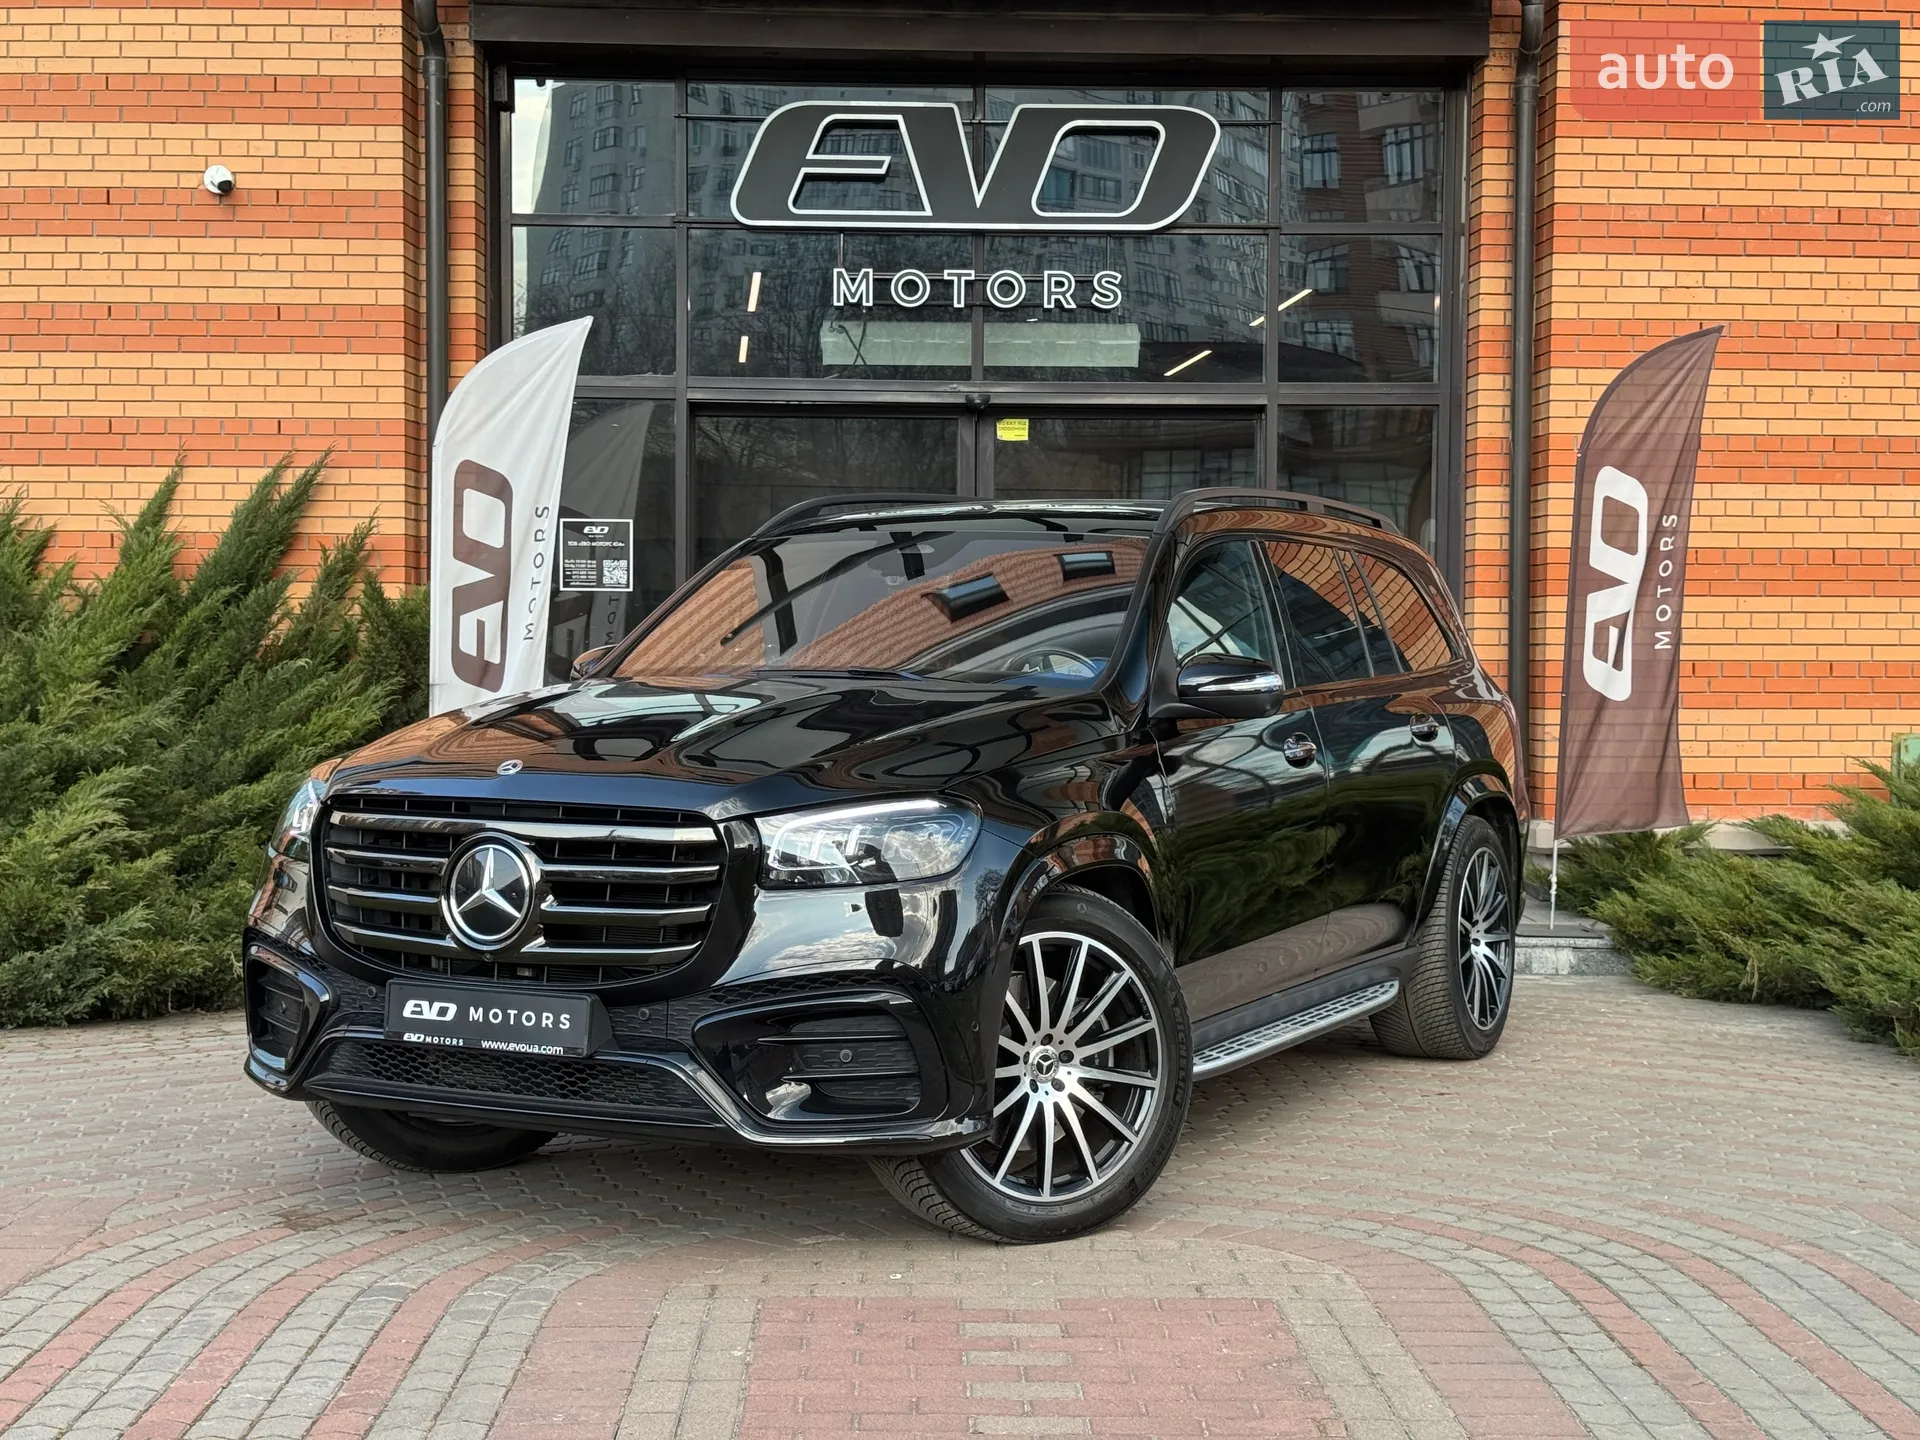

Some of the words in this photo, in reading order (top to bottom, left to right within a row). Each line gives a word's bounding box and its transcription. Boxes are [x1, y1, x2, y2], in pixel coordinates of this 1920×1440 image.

[730, 100, 1221, 231] EVO
[832, 268, 1123, 309] MOTORS
[583, 525, 609, 534] EVO
[451, 459, 514, 693] EVO
[523, 505, 549, 641] MOTORS
[1583, 465, 1648, 701] EVO
[1654, 513, 1678, 650] MOTORS
[402, 999, 457, 1022] EVO
[469, 1006, 571, 1030] MOTORS
[402, 1032, 425, 1042] EVO
[425, 1036, 464, 1046] MOTORS
[481, 1040, 564, 1055] www.evoua.com
